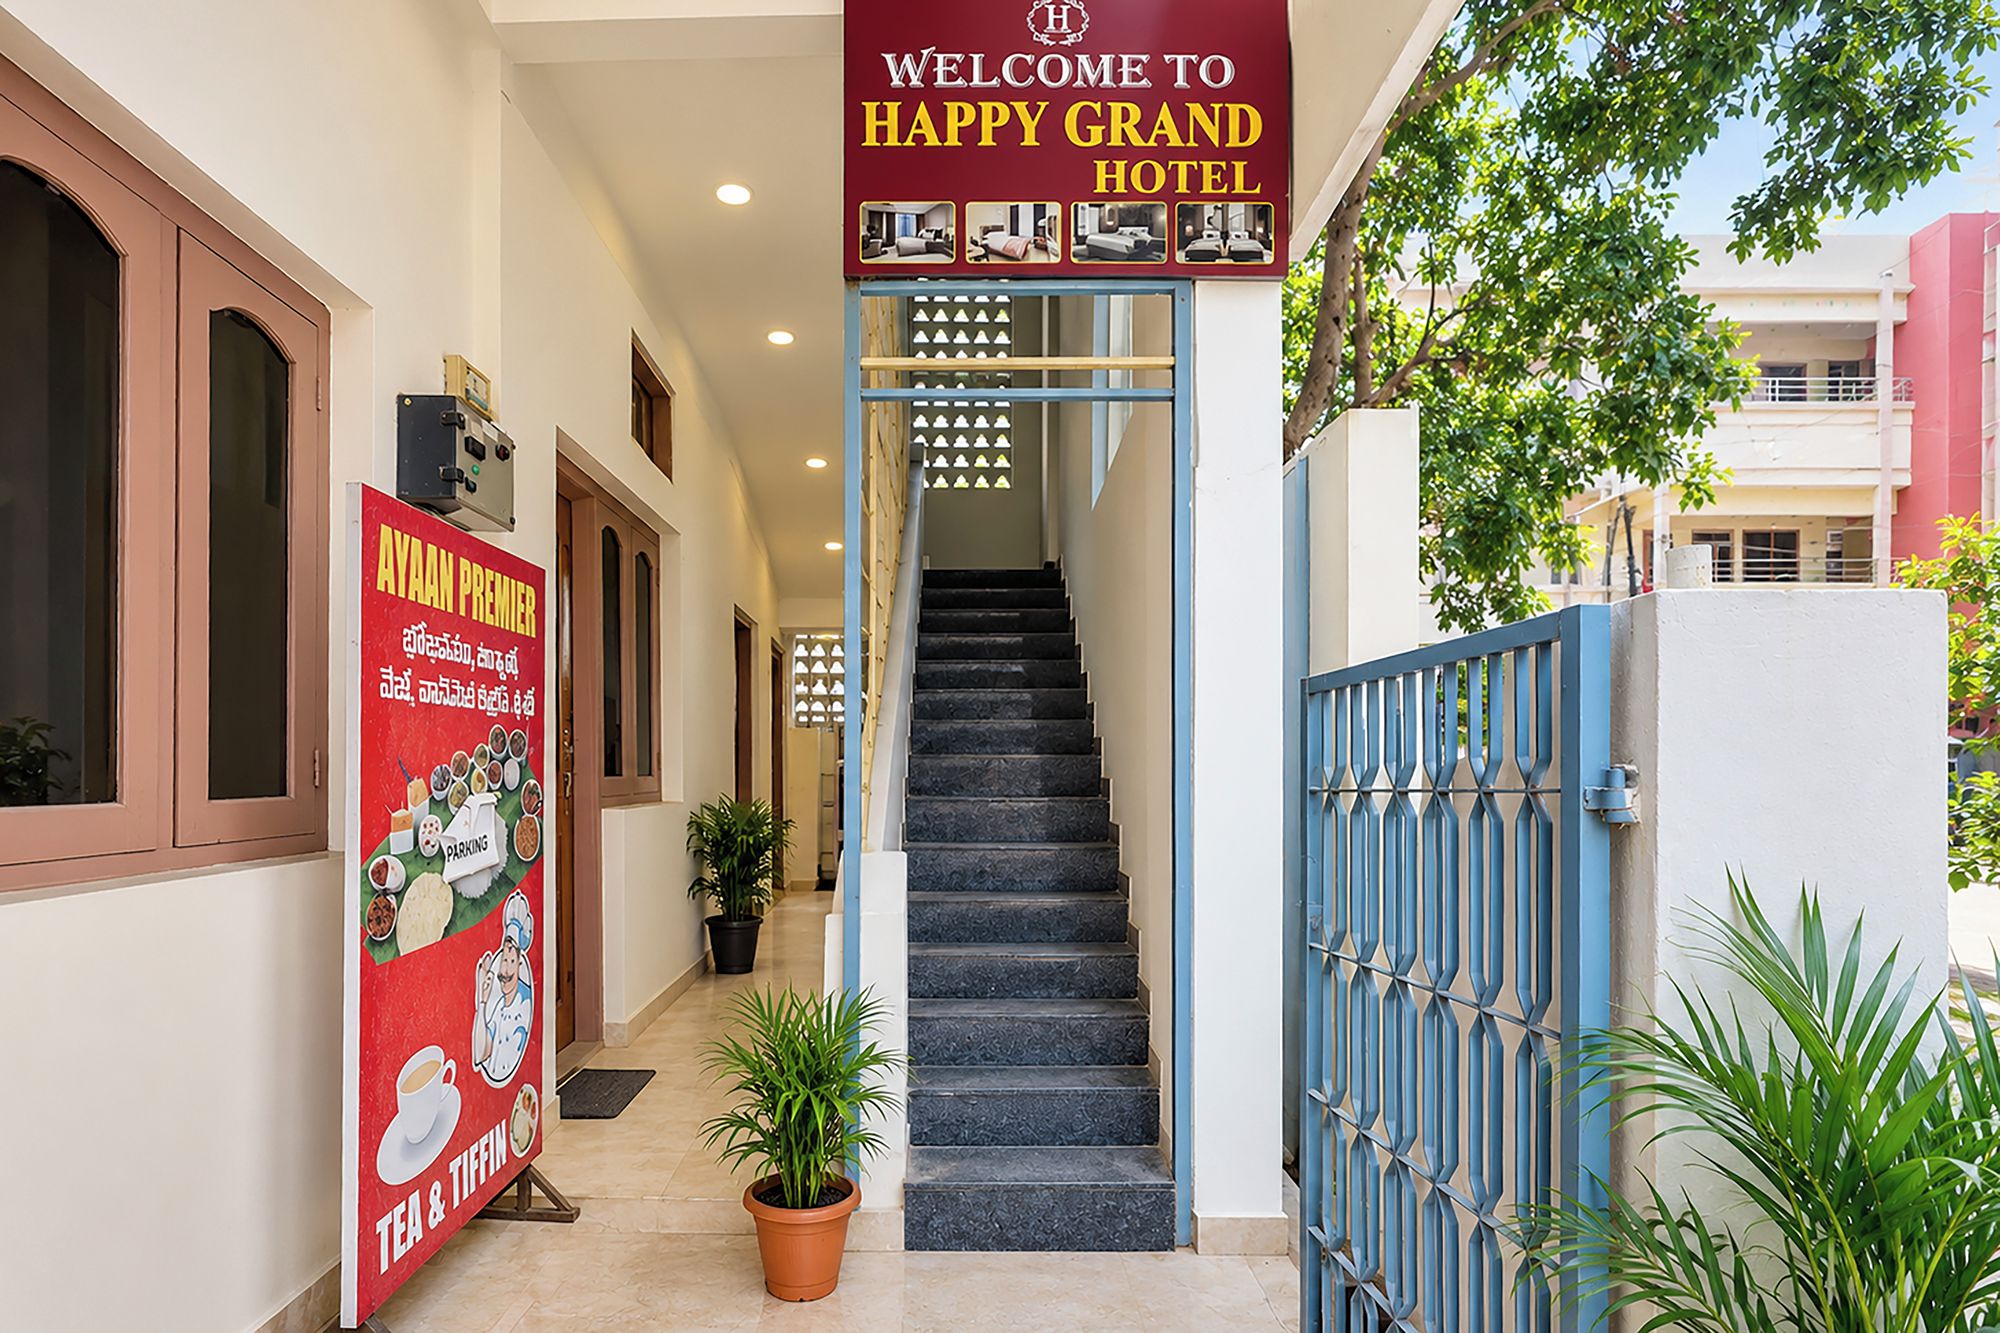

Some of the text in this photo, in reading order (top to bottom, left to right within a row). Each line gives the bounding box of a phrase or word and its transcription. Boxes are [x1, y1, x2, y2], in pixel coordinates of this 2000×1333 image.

[1043, 4, 1072, 33] H
[881, 46, 1236, 89] WELCOME TO
[861, 101, 1263, 148] HAPPY GRAND
[1093, 159, 1261, 195] HOTEL
[376, 523, 537, 638] AYAAN PREMIER
[446, 834, 489, 862] PARKING
[375, 1119, 508, 1275] TEA & TIFFIN
